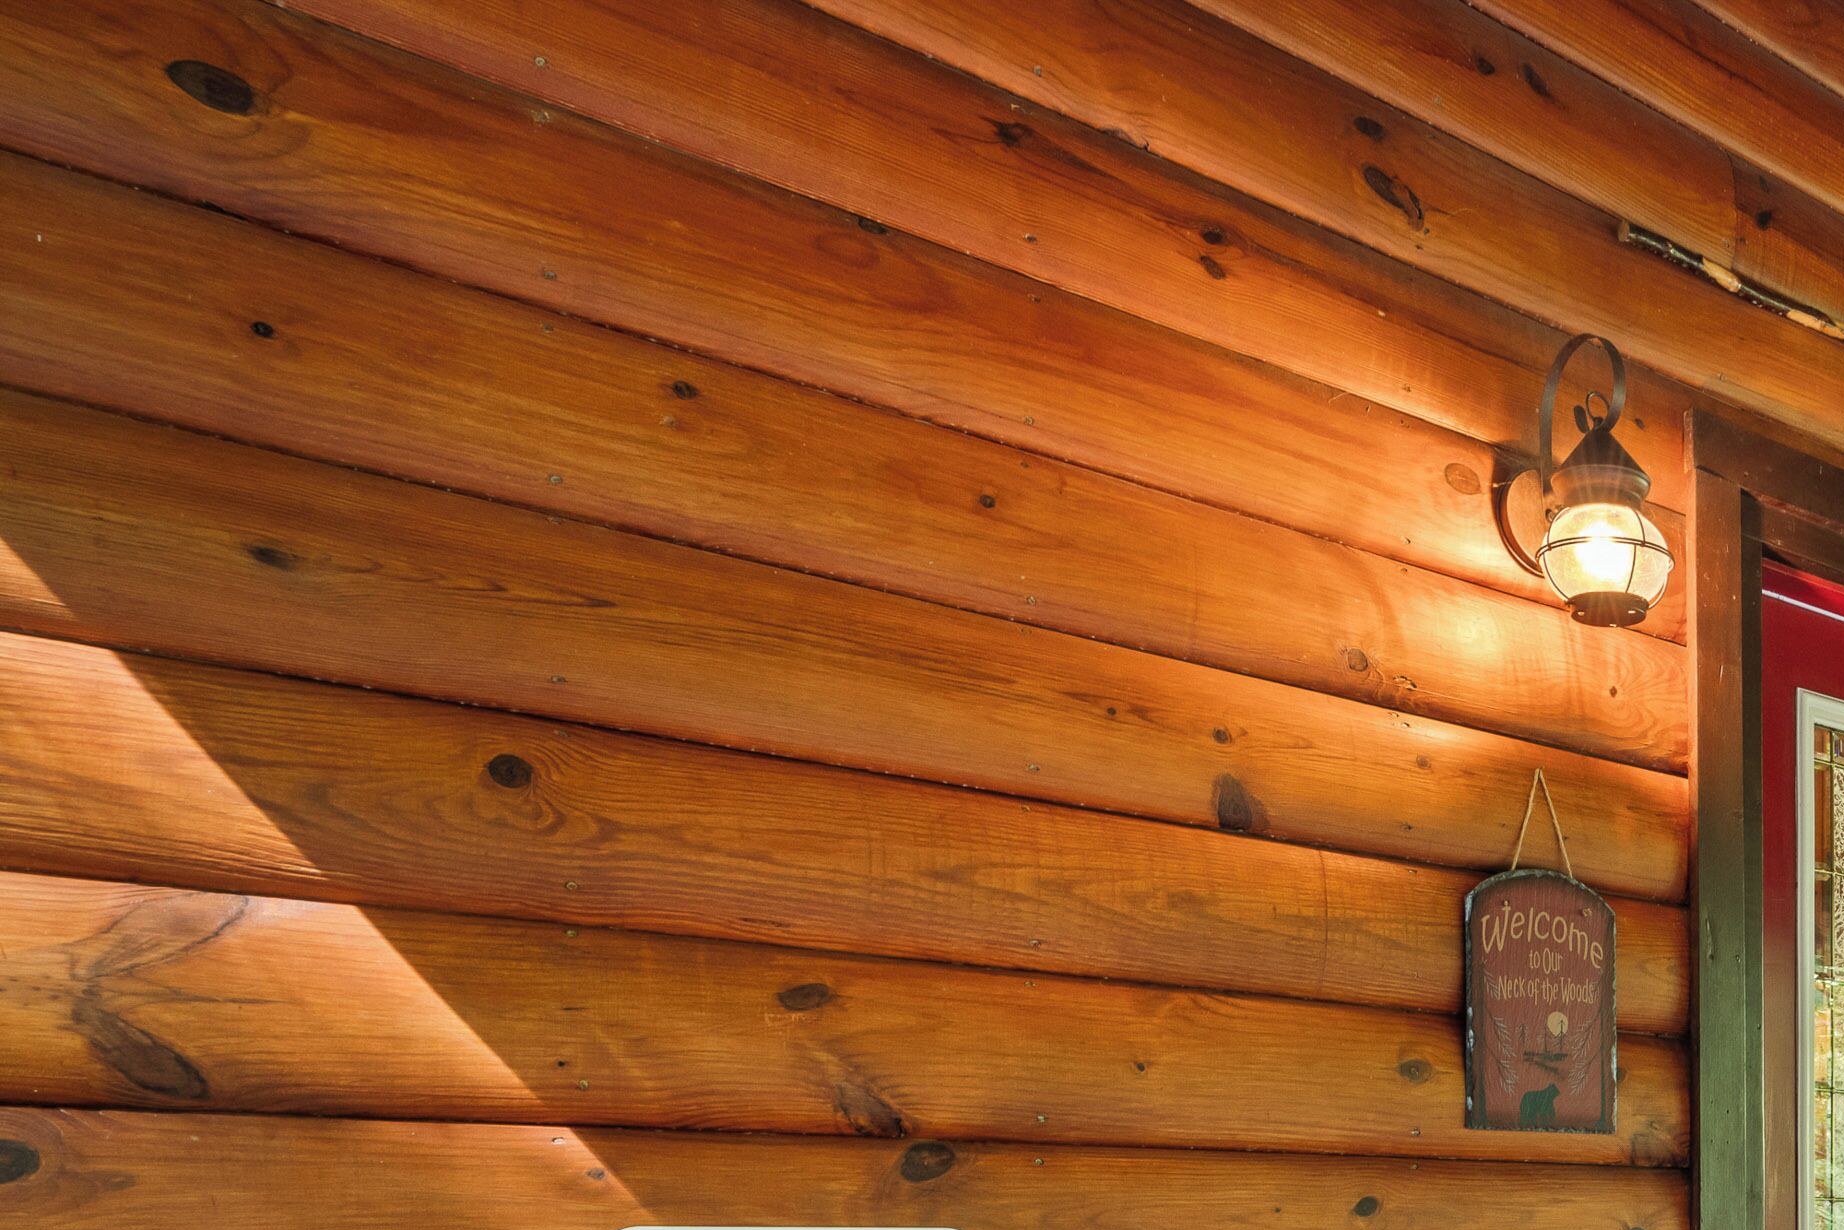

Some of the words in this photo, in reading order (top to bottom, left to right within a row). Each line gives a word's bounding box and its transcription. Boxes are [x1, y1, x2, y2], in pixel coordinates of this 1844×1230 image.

[1480, 905, 1604, 969] Welcome
[1528, 949, 1541, 969] to
[1542, 947, 1563, 975] Our
[1498, 975, 1526, 1000] Neck
[1527, 977, 1540, 1006] of
[1541, 977, 1559, 1006] the
